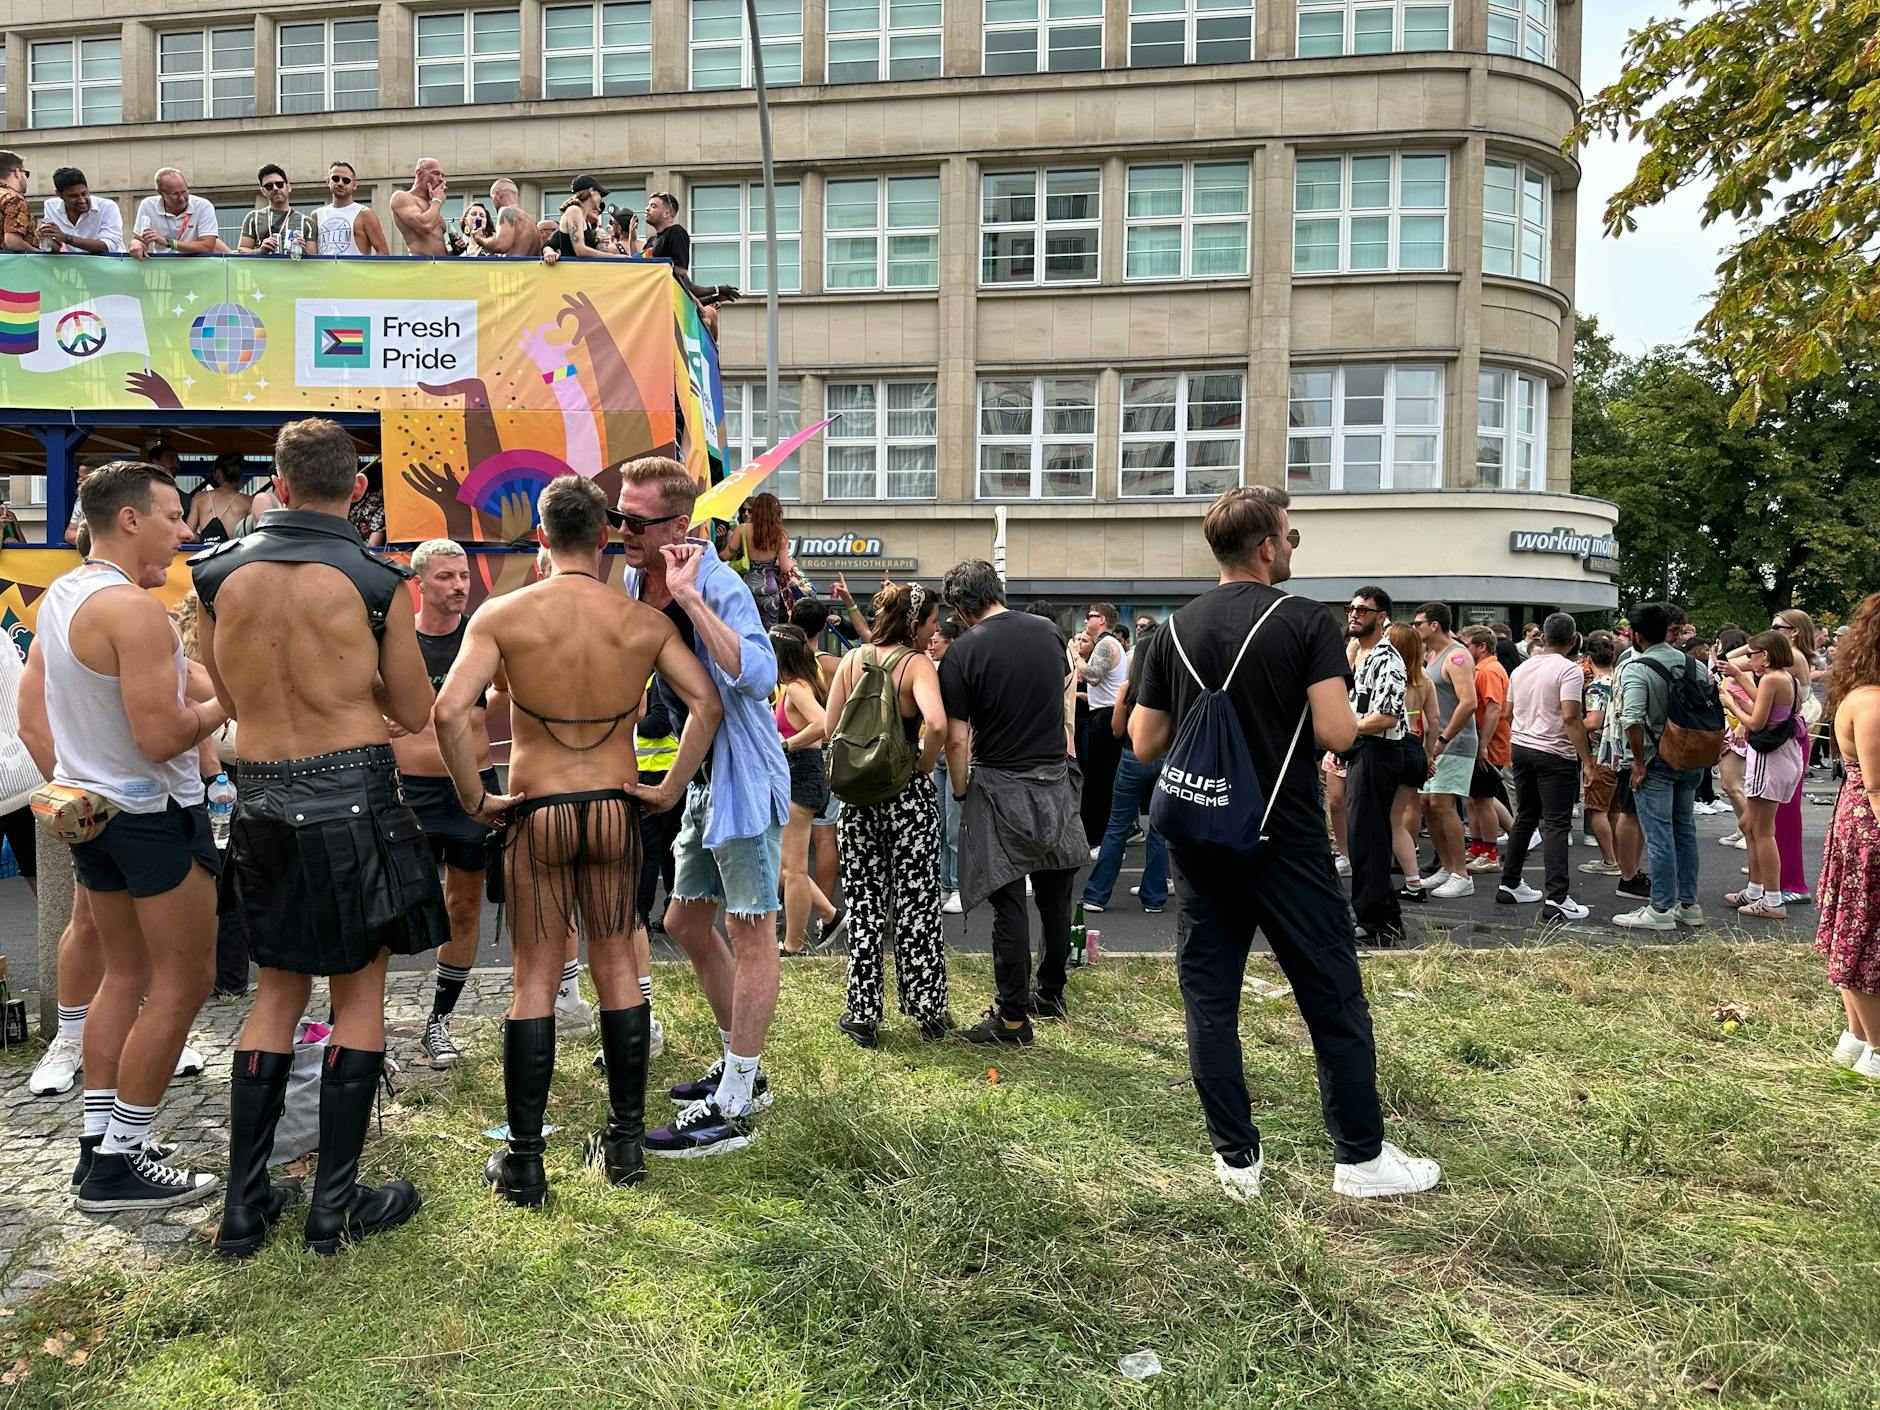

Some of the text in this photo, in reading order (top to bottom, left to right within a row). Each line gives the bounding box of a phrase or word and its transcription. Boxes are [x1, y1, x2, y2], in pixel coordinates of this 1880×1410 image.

[383, 315, 460, 338] Fresh
[383, 347, 457, 370] Pride
[801, 533, 881, 554] motion
[1516, 529, 1618, 557] working moti
[802, 559, 827, 567] ERGO
[835, 559, 914, 568] PHYSIOTHERAPIE
